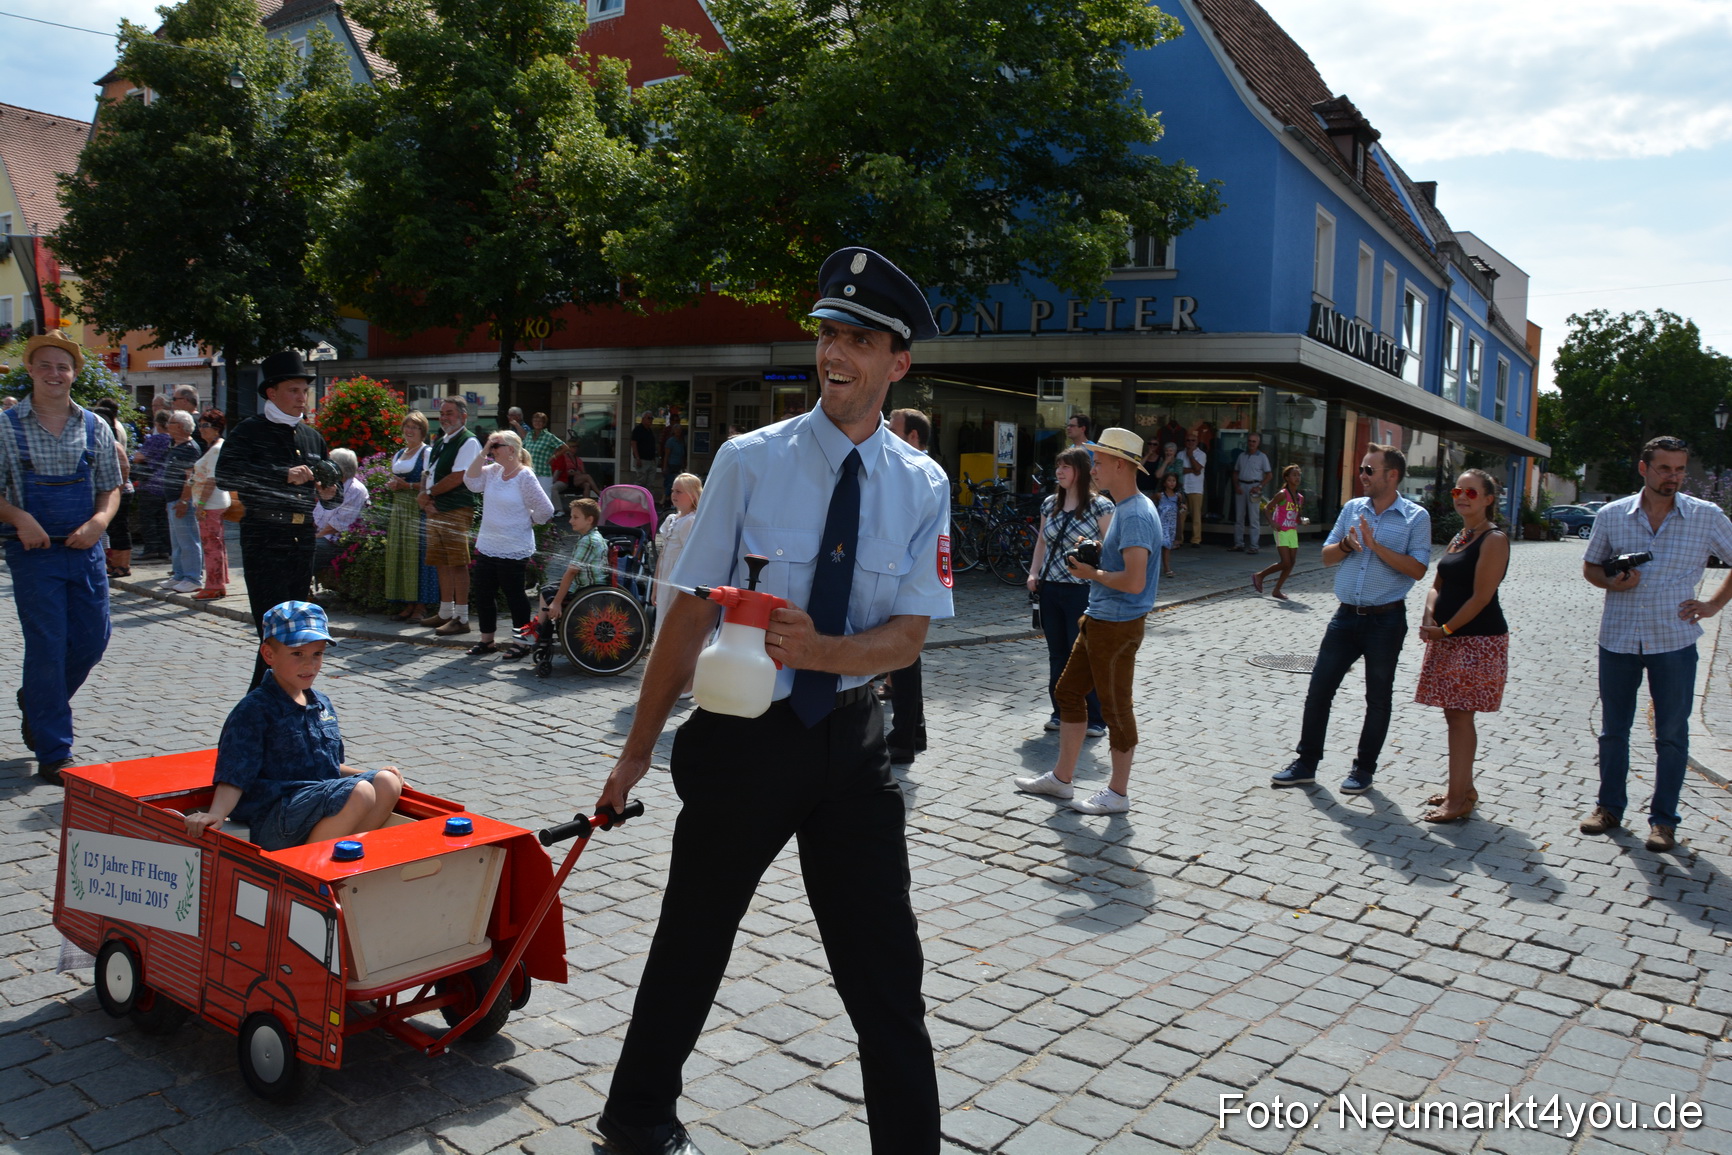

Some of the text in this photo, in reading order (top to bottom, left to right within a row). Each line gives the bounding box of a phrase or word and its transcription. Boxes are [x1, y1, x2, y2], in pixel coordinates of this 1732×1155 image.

[934, 296, 1199, 336] ON PETER
[1316, 304, 1367, 358] ANTON
[84, 851, 178, 890] 125 Jahre FF Heng
[89, 878, 169, 909] 19.-21. Juni 2015
